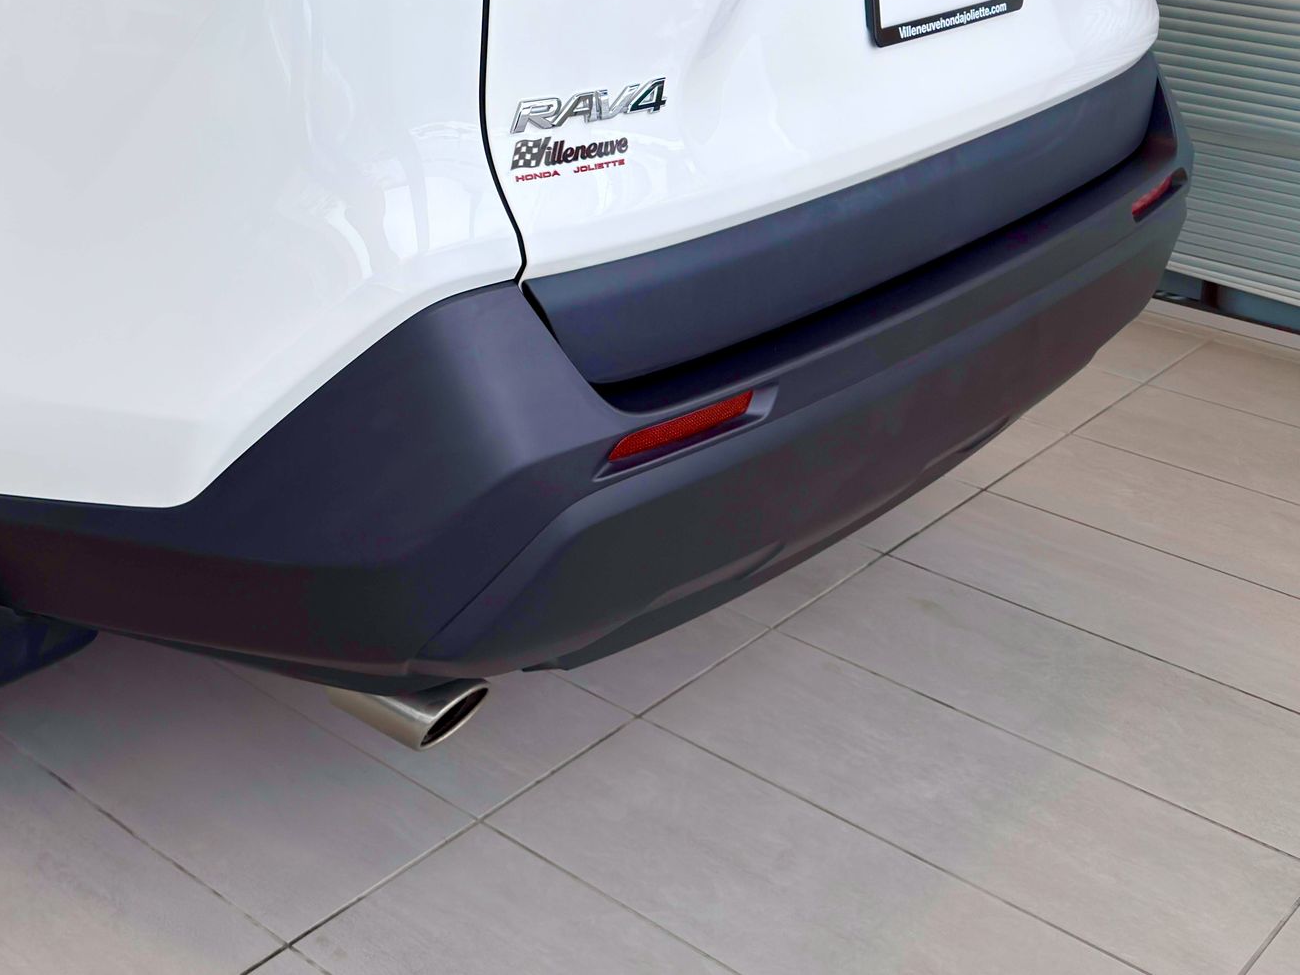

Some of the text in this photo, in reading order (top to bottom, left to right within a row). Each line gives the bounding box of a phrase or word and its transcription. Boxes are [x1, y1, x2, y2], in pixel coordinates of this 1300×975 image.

[510, 77, 667, 134] RAV4
[511, 137, 628, 171] Villeneuve
[515, 158, 626, 183] HONDA JOLIETTE
